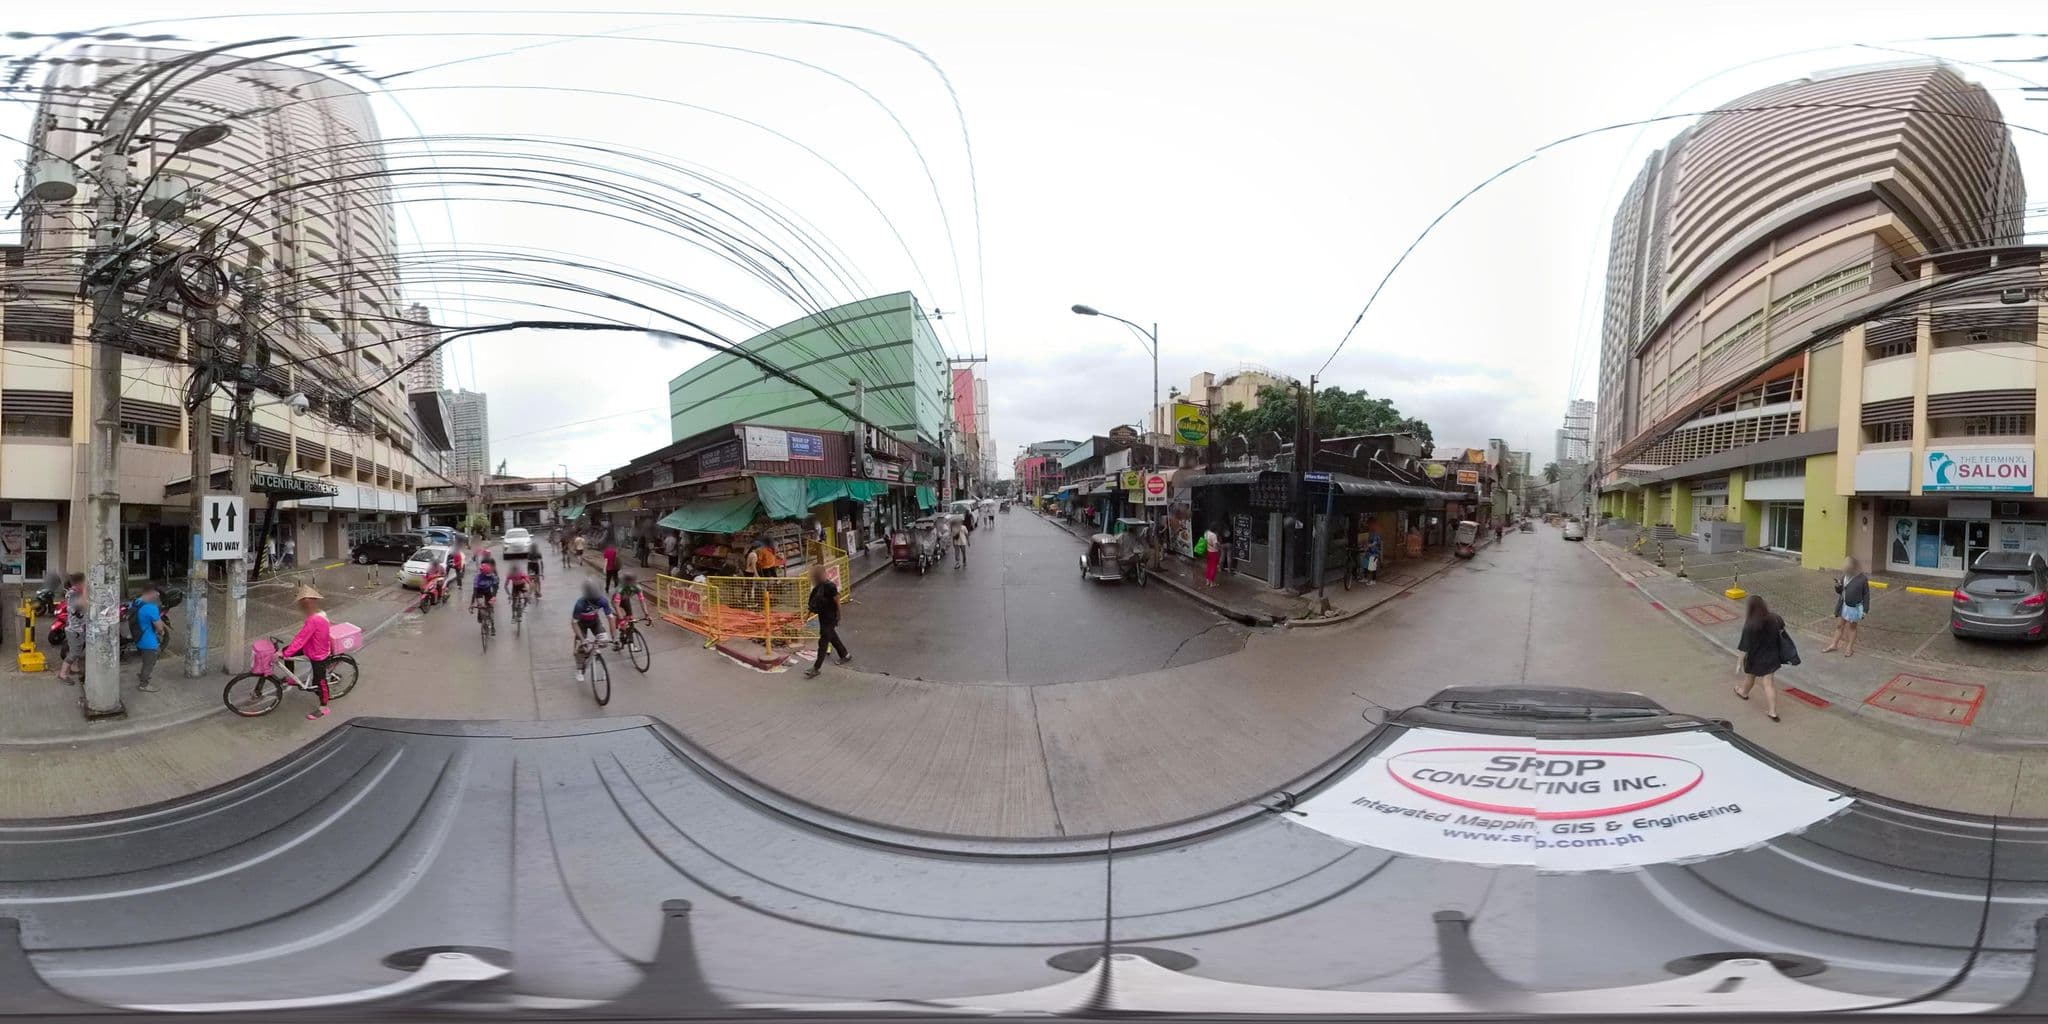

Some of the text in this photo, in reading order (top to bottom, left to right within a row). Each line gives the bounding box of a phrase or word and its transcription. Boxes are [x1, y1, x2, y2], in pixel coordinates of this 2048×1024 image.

[1959, 465, 2027, 477] SALON
[267, 477, 303, 490] CENTRAL
[206, 541, 240, 552] TWO WAY
[1485, 756, 1605, 777] SRDP
[1412, 768, 1667, 795] CONSULTING INC.
[1352, 797, 1450, 822] Integrated
[1551, 822, 1596, 835] GIS
[1605, 820, 1623, 832] &
[1633, 803, 1741, 829] Engineering
